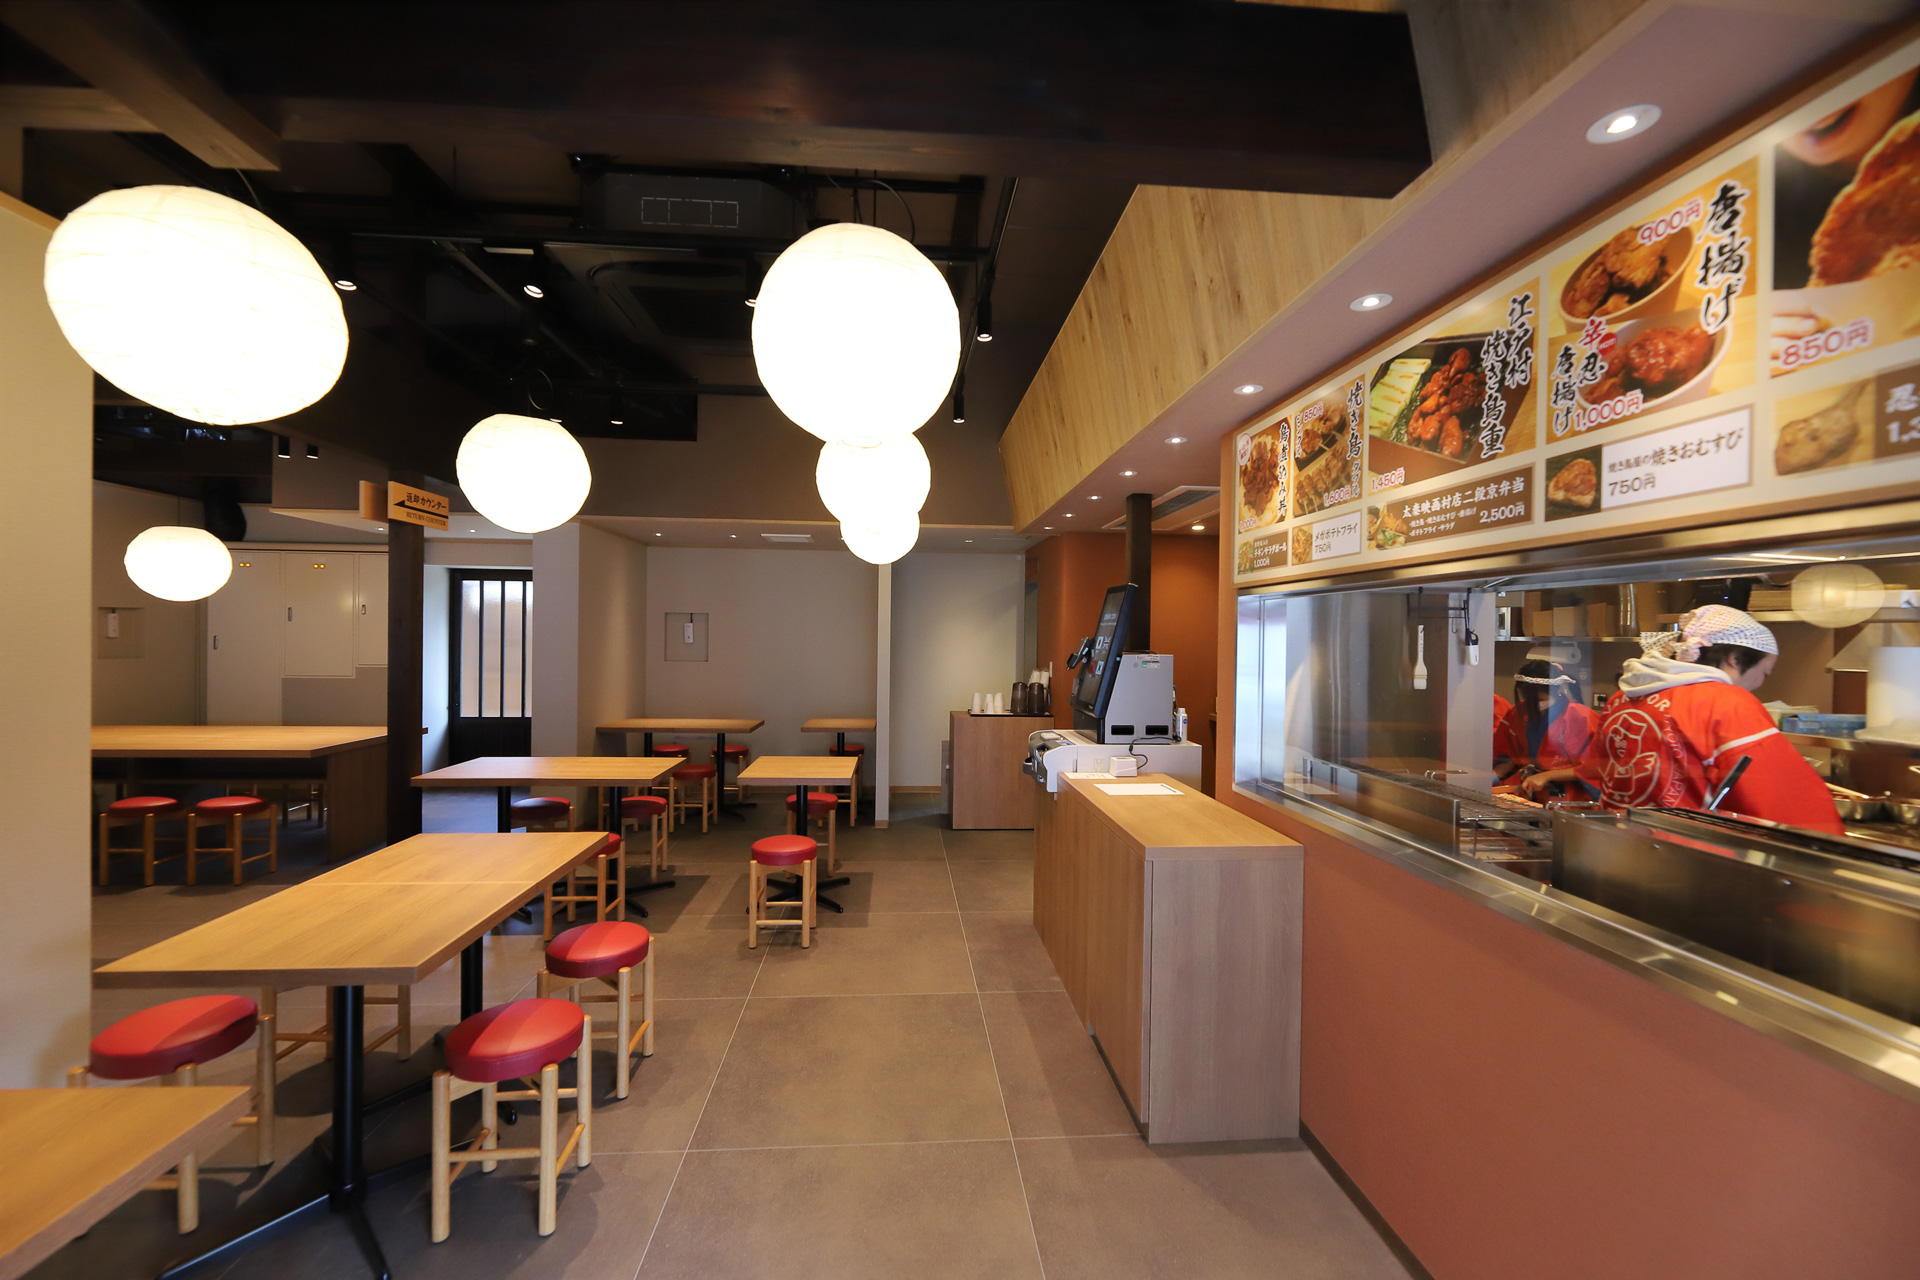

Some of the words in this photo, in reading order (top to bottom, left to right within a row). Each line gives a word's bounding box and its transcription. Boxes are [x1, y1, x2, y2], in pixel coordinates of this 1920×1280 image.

[1639, 198, 1701, 245] 900円
[1506, 293, 1533, 388] 江戸村
[1781, 318, 1873, 368] 850円
[1481, 328, 1507, 458] 焼き鳥重
[1576, 391, 1642, 431] 1,000円
[1371, 468, 1405, 492] 1,450円
[1609, 473, 1656, 496] 750円
[406, 492, 447, 510] 返却カウンター
[1324, 485, 1351, 507] 1,600円
[406, 511, 424, 521] RETURN
[425, 516, 446, 526] COUNTER
[1480, 502, 1525, 524] 2,500円
[1315, 522, 1358, 541] メガポテトフライ
[1315, 542, 1331, 553] 750円
